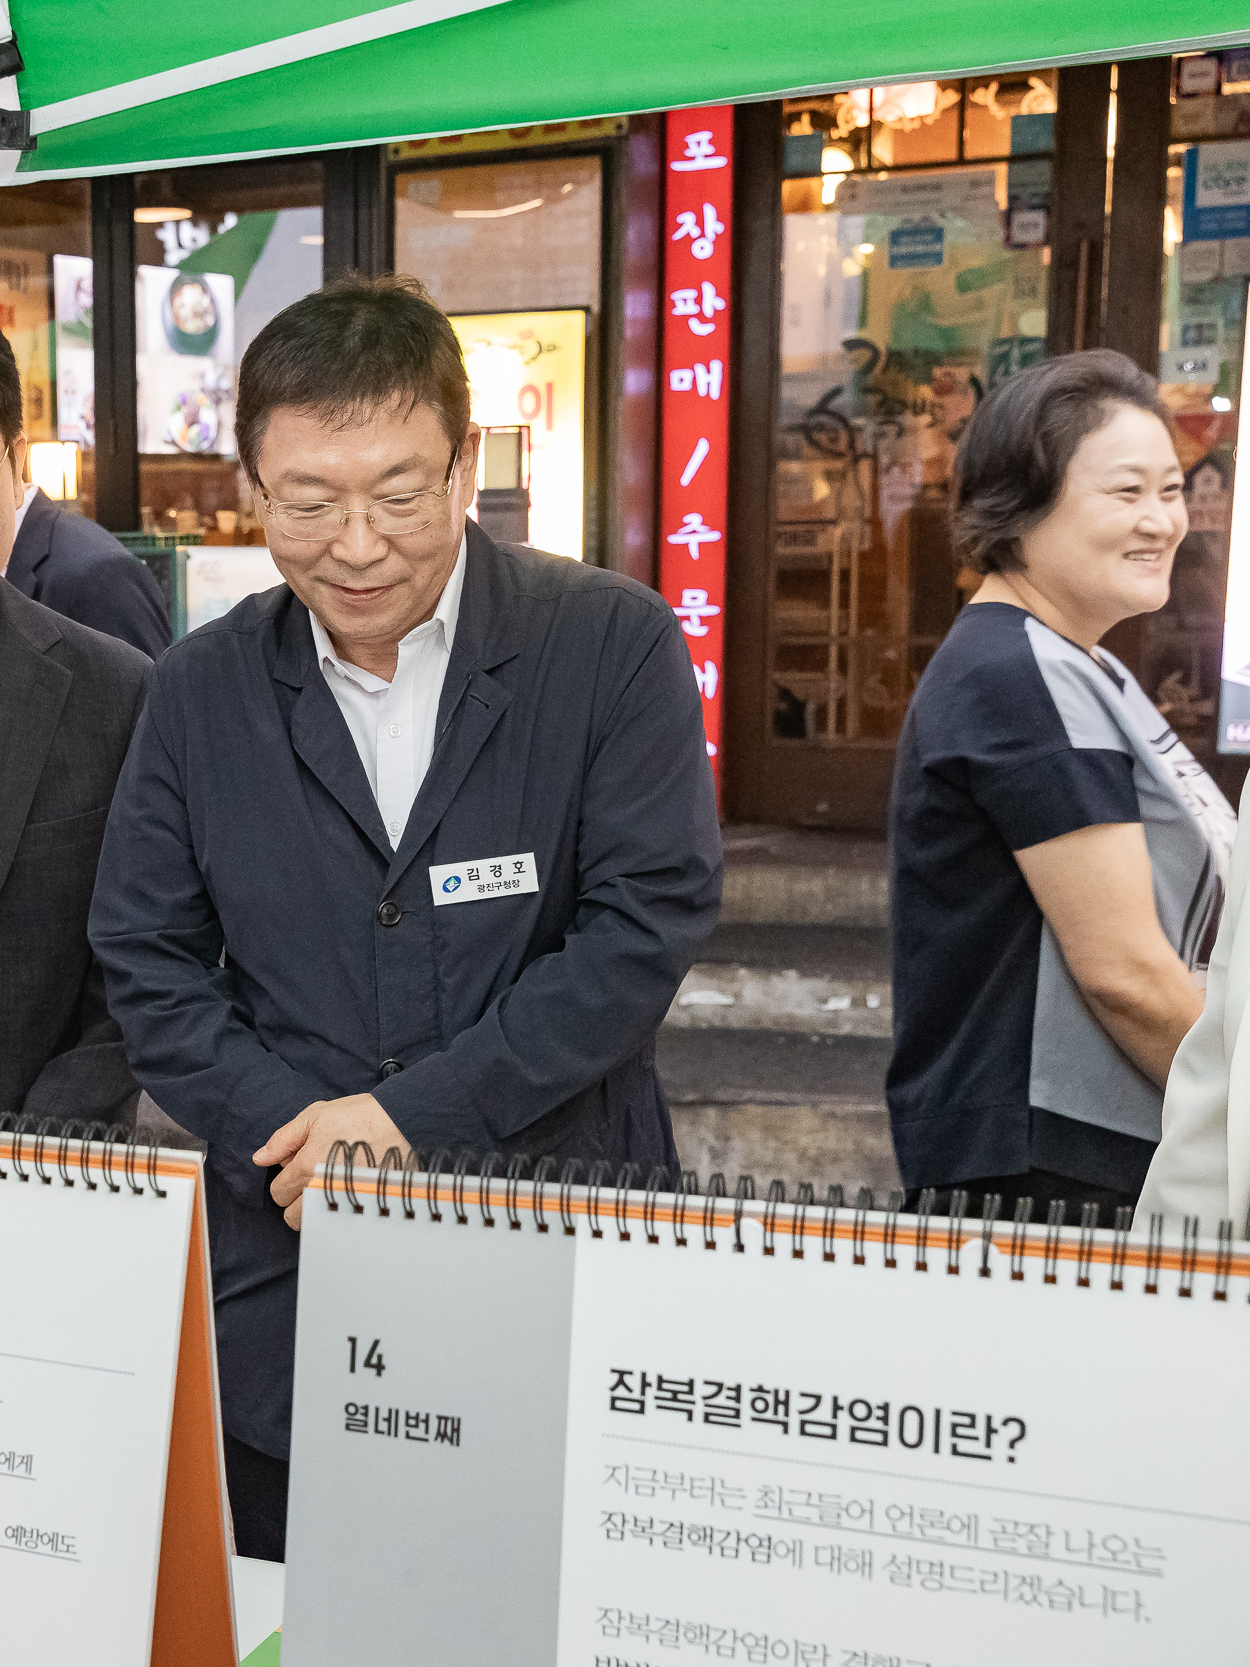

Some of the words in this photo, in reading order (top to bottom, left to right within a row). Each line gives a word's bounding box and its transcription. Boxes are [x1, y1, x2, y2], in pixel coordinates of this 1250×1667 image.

[477, 879, 520, 893] 광진구청장
[346, 1336, 387, 1378] 14
[343, 1401, 463, 1448] 열네번째
[608, 1367, 1028, 1464] 잠복결핵감염이란?
[4, 1525, 78, 1556] 예방에도
[602, 1463, 748, 1512] 지금부터는
[751, 1484, 875, 1531] 최근들어
[883, 1499, 979, 1546] 언론에
[988, 1515, 1056, 1557] 곧잘
[1062, 1528, 1168, 1572] 나오는
[598, 1510, 805, 1571] 잠복결핵감염에
[812, 1543, 875, 1582] 대해
[880, 1552, 1152, 1624] 설명드리겠습니다.
